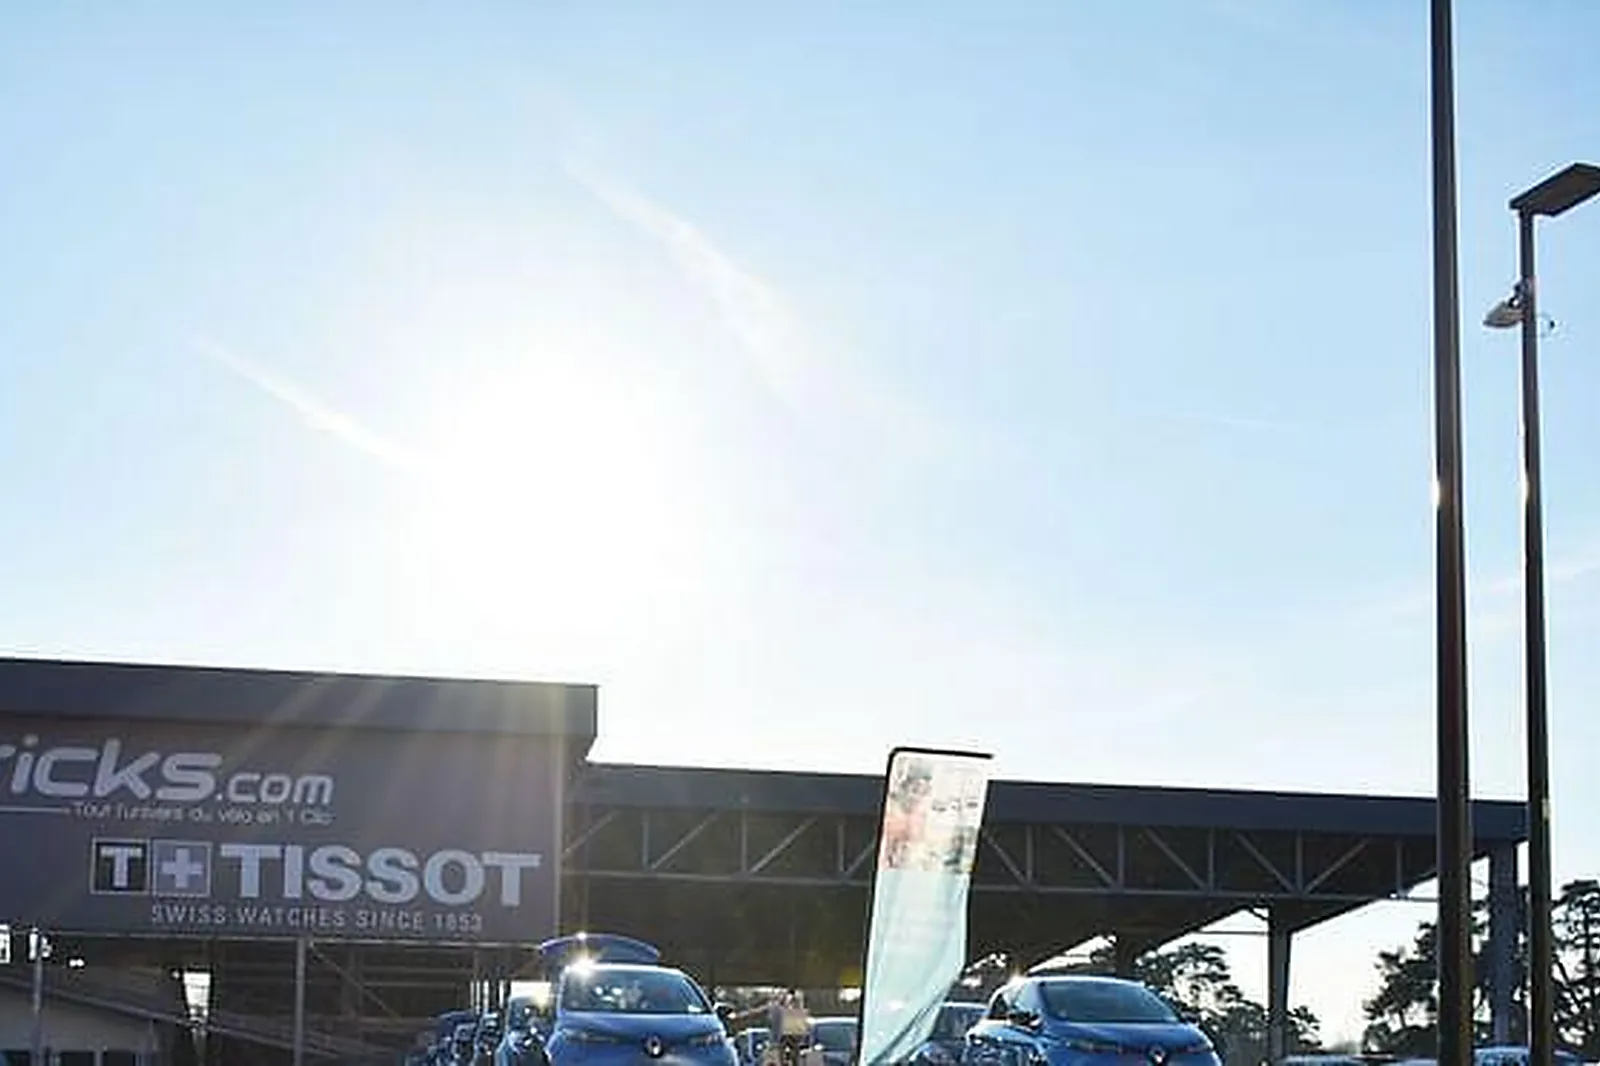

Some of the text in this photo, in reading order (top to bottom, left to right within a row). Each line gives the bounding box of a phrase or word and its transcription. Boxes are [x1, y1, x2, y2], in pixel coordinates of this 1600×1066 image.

[101, 843, 541, 906] T TISSOT
[152, 904, 226, 924] SWISS
[237, 907, 345, 928] WATCHES
[355, 910, 424, 931] SINCE
